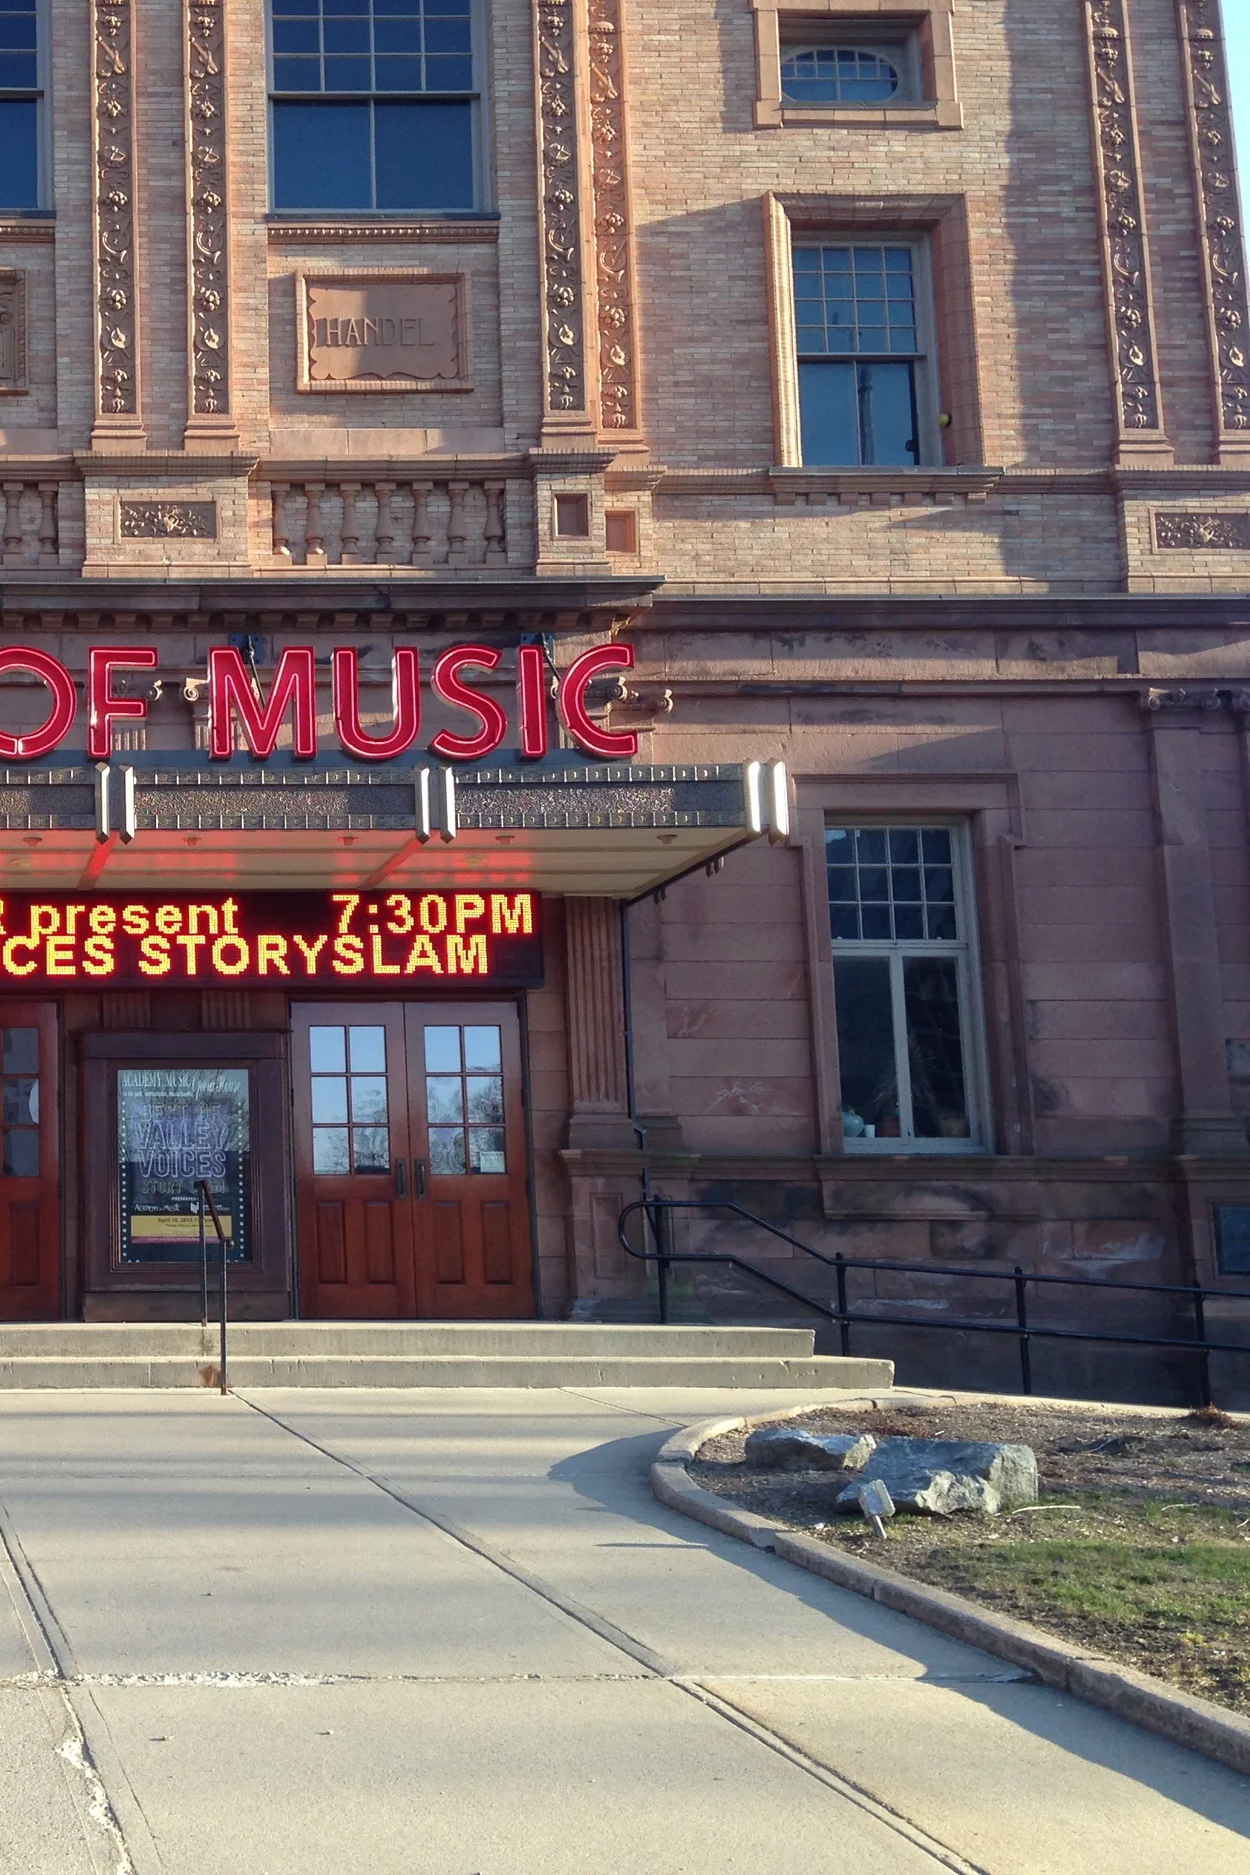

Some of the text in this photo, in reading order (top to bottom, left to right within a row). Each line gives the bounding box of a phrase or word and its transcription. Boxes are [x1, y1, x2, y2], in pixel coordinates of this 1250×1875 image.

[325, 316, 435, 347] HANDEL
[206, 643, 639, 761] MUSIC
[29, 896, 239, 945] present
[330, 893, 534, 935] 7:30PM
[137, 934, 489, 976] STORYSLAM
[122, 1072, 161, 1087] ACADEMY
[142, 1103, 221, 1122] BEST OF
[134, 1121, 227, 1150] VALLEY
[137, 1149, 227, 1178] VOICES
[141, 1179, 183, 1194] STORY
